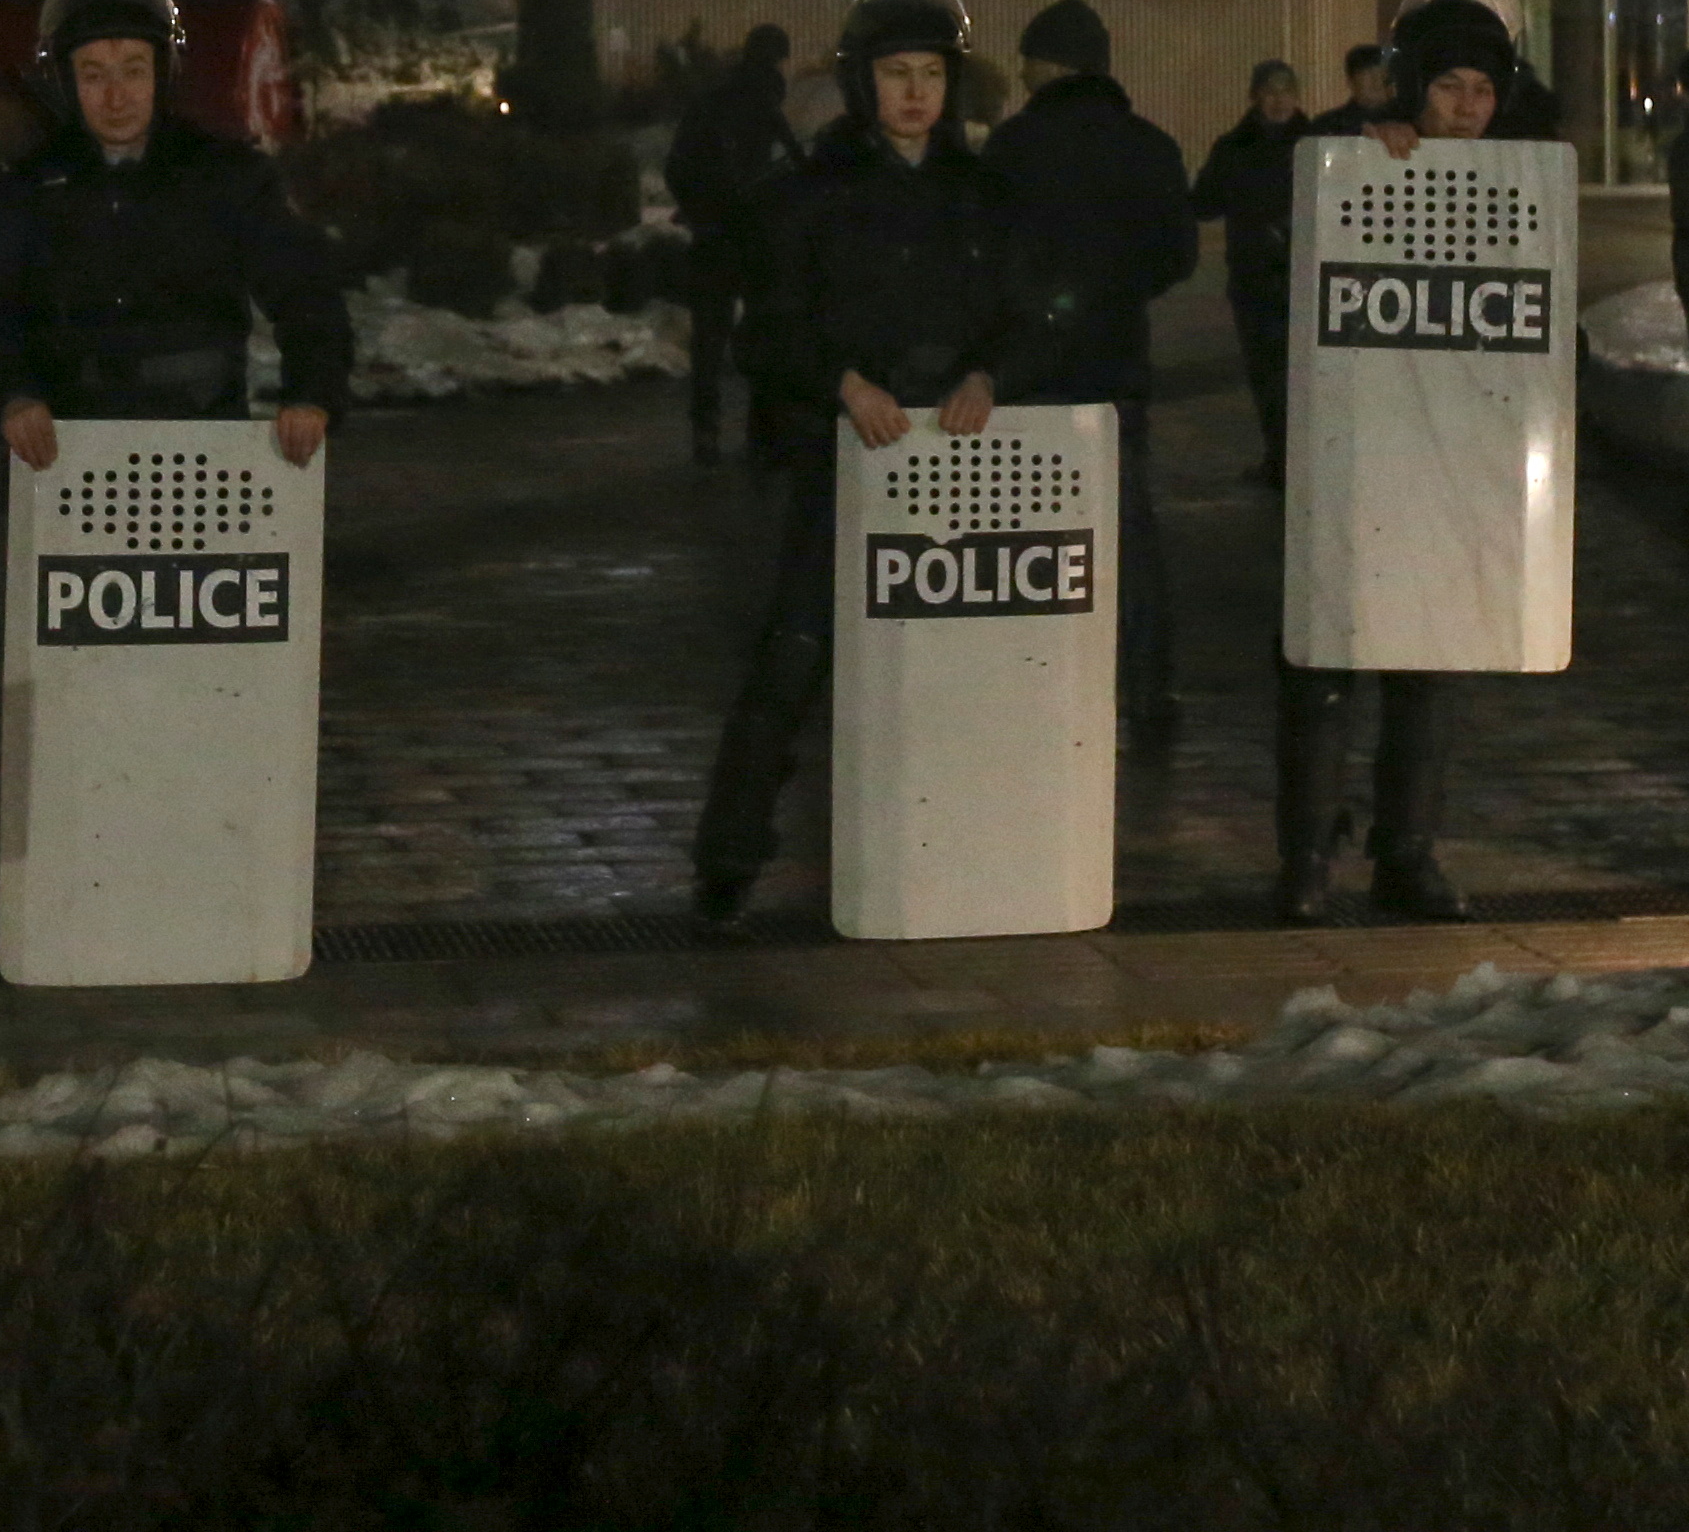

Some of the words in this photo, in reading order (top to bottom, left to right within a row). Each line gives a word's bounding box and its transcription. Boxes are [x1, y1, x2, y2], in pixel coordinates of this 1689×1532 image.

[1328, 276, 1543, 339] POLICE
[48, 569, 279, 630] POLICE
[876, 544, 1086, 604] POLICE
